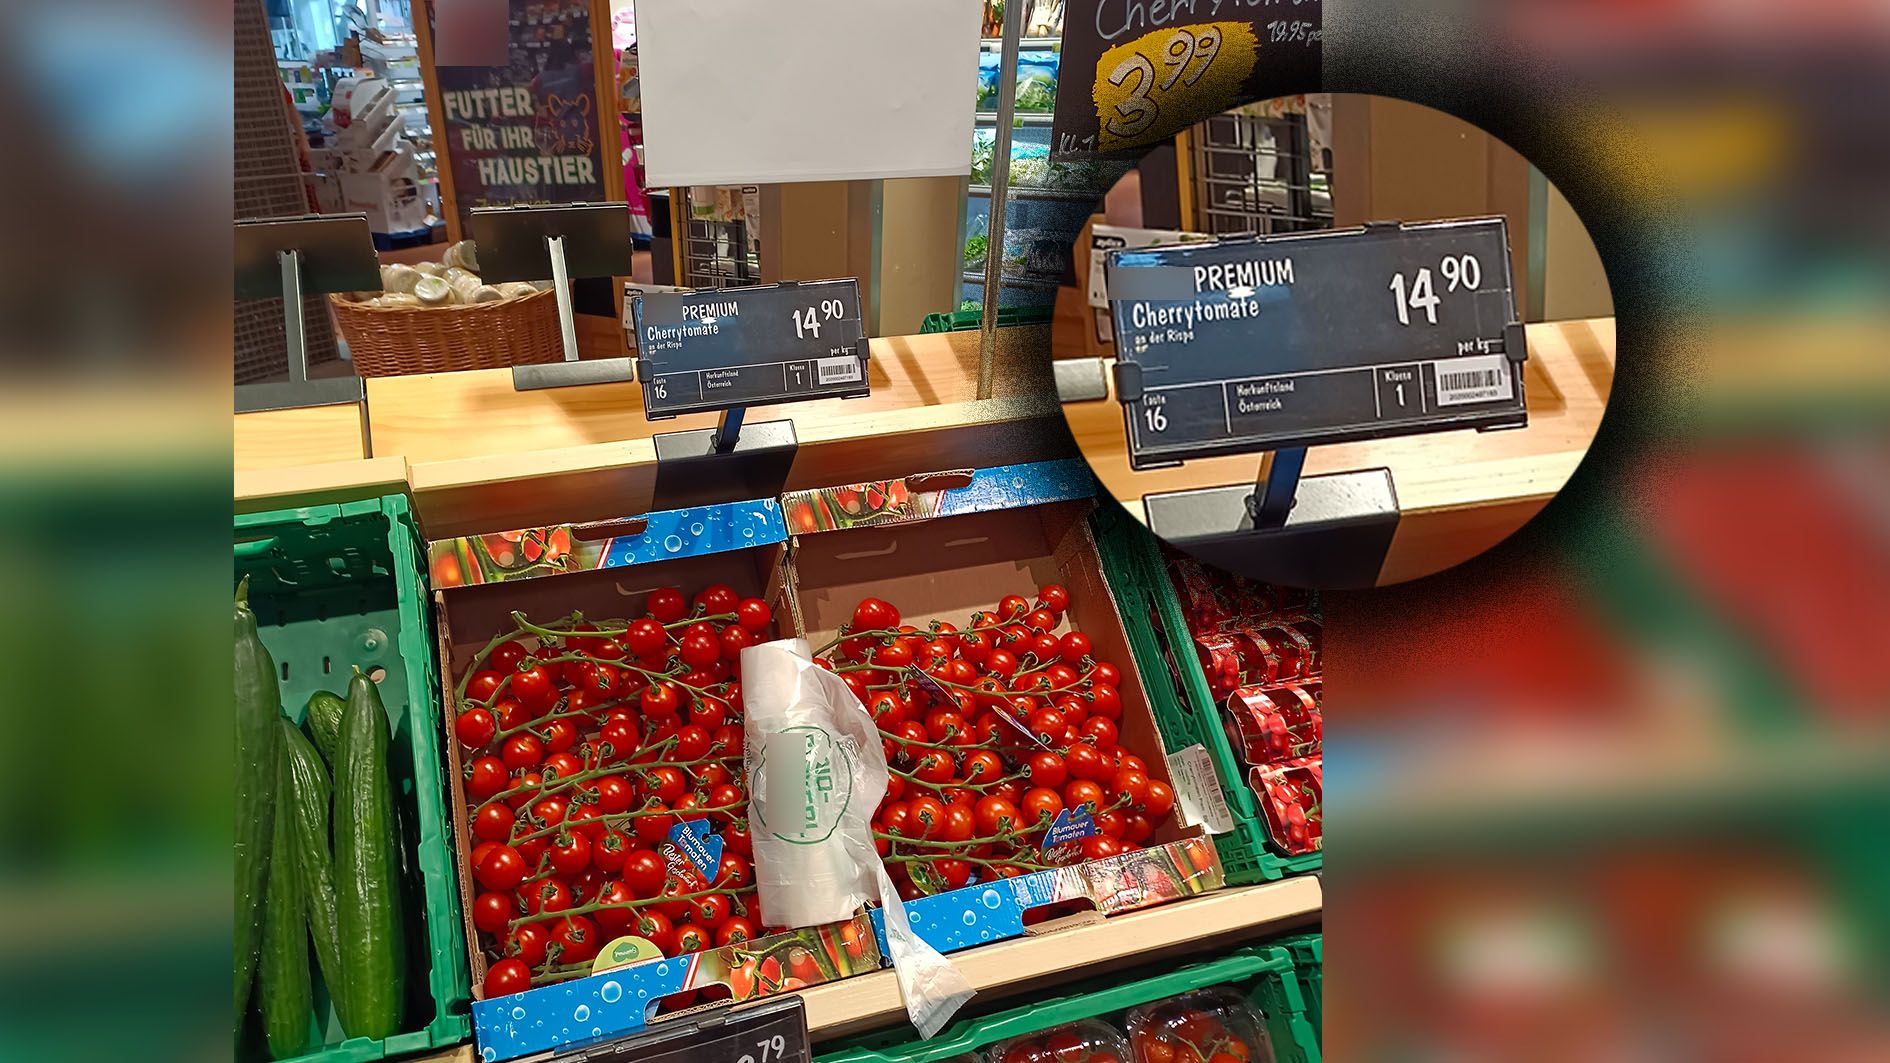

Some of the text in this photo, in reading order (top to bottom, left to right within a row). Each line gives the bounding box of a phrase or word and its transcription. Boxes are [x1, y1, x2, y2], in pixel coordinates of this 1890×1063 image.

[443, 87, 534, 120] FUTTER
[460, 123, 535, 150] FÜR IHR
[477, 156, 596, 186] HAUSTIER
[1194, 258, 1294, 292] PREMIUM
[682, 302, 739, 320] PREMIUM
[1132, 300, 1260, 329] Cherrytomate
[646, 324, 719, 341] Cherrytomate
[1150, 331, 1165, 344] der
[795, 372, 801, 385] 1
[654, 385, 667, 399] 16
[1395, 384, 1405, 406] 1
[1238, 398, 1282, 413] Österreich
[1145, 407, 1168, 431] 16
[1052, 821, 1089, 836] Blumauer
[1052, 830, 1085, 844] Tomaten
[677, 834, 707, 871] Tomaten
[682, 826, 716, 864] Blumauer
